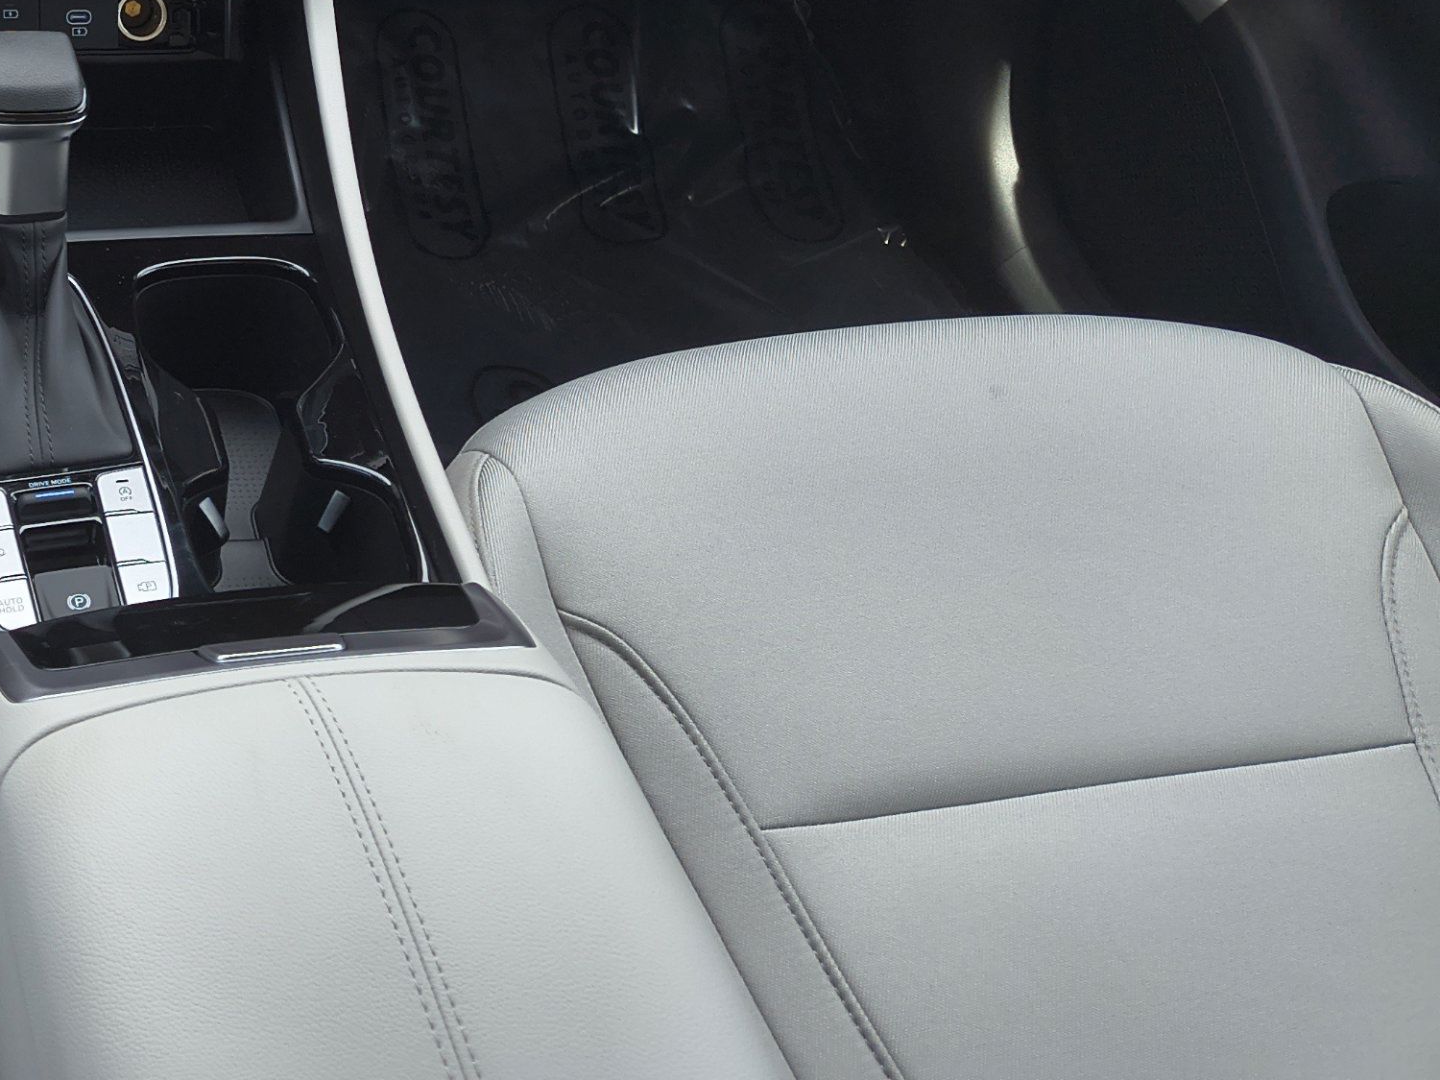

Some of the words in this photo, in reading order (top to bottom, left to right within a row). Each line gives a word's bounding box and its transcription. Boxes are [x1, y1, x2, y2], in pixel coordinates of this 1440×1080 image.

[28, 480, 49, 488] DRIVE
[51, 476, 71, 486] MODE
[0, 605, 24, 613] HOLD
